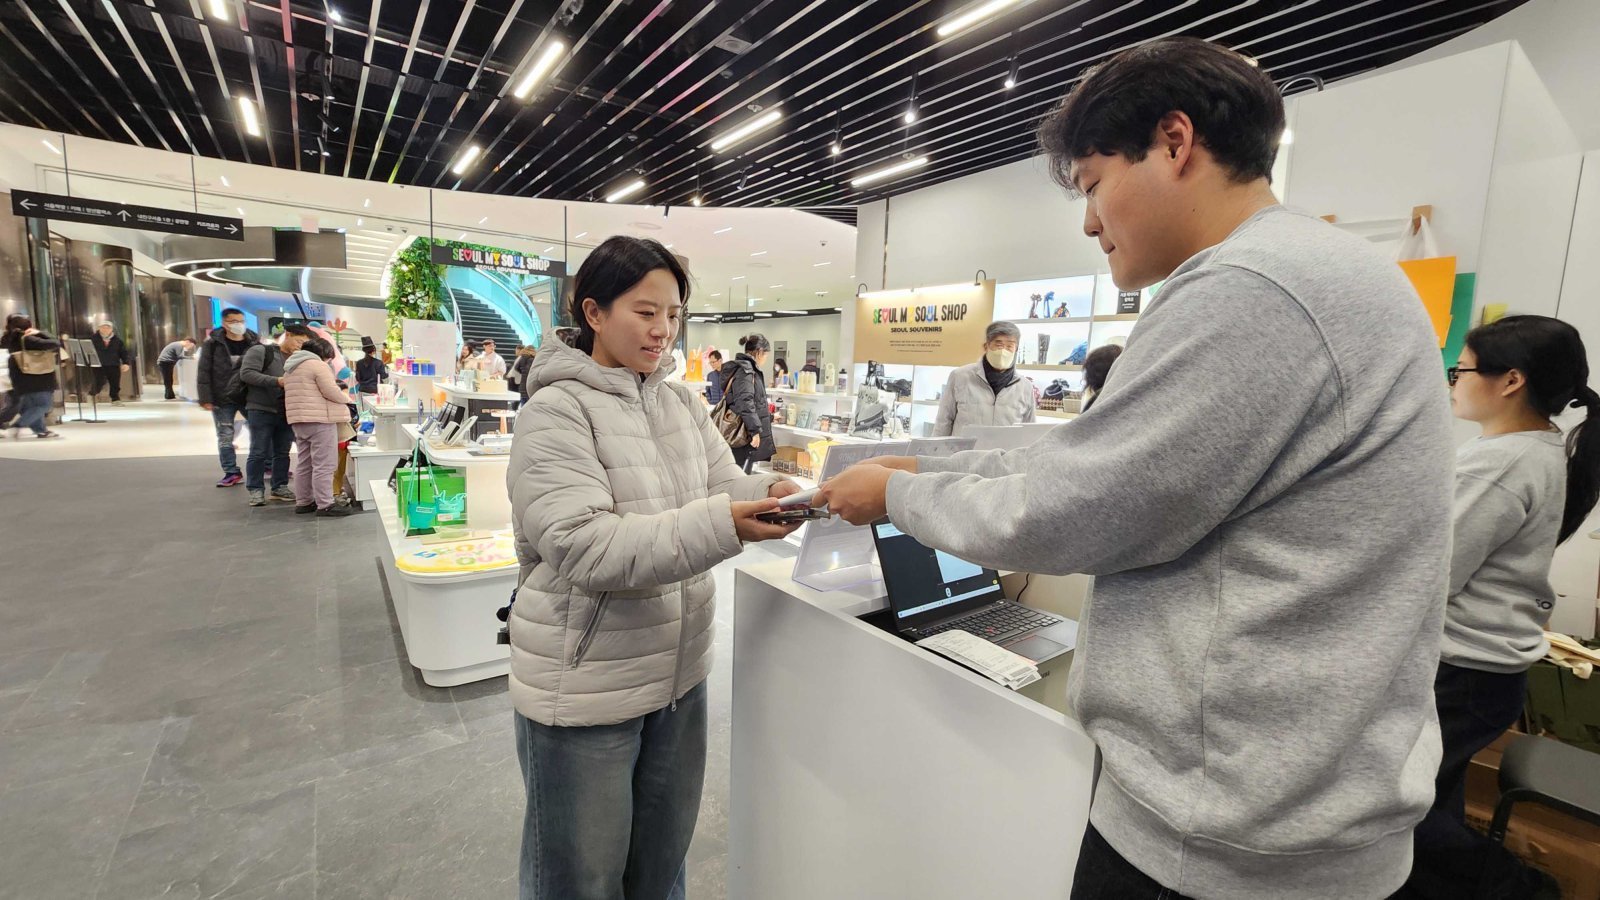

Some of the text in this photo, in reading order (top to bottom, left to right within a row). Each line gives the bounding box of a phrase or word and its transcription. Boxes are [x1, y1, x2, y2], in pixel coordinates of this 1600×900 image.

[452, 248, 484, 263] SEOUL
[501, 254, 526, 269] SOUL
[526, 258, 550, 271] SHOP
[873, 307, 898, 324] SEOUL
[915, 304, 938, 323] SOUL
[942, 304, 968, 321] SHOP
